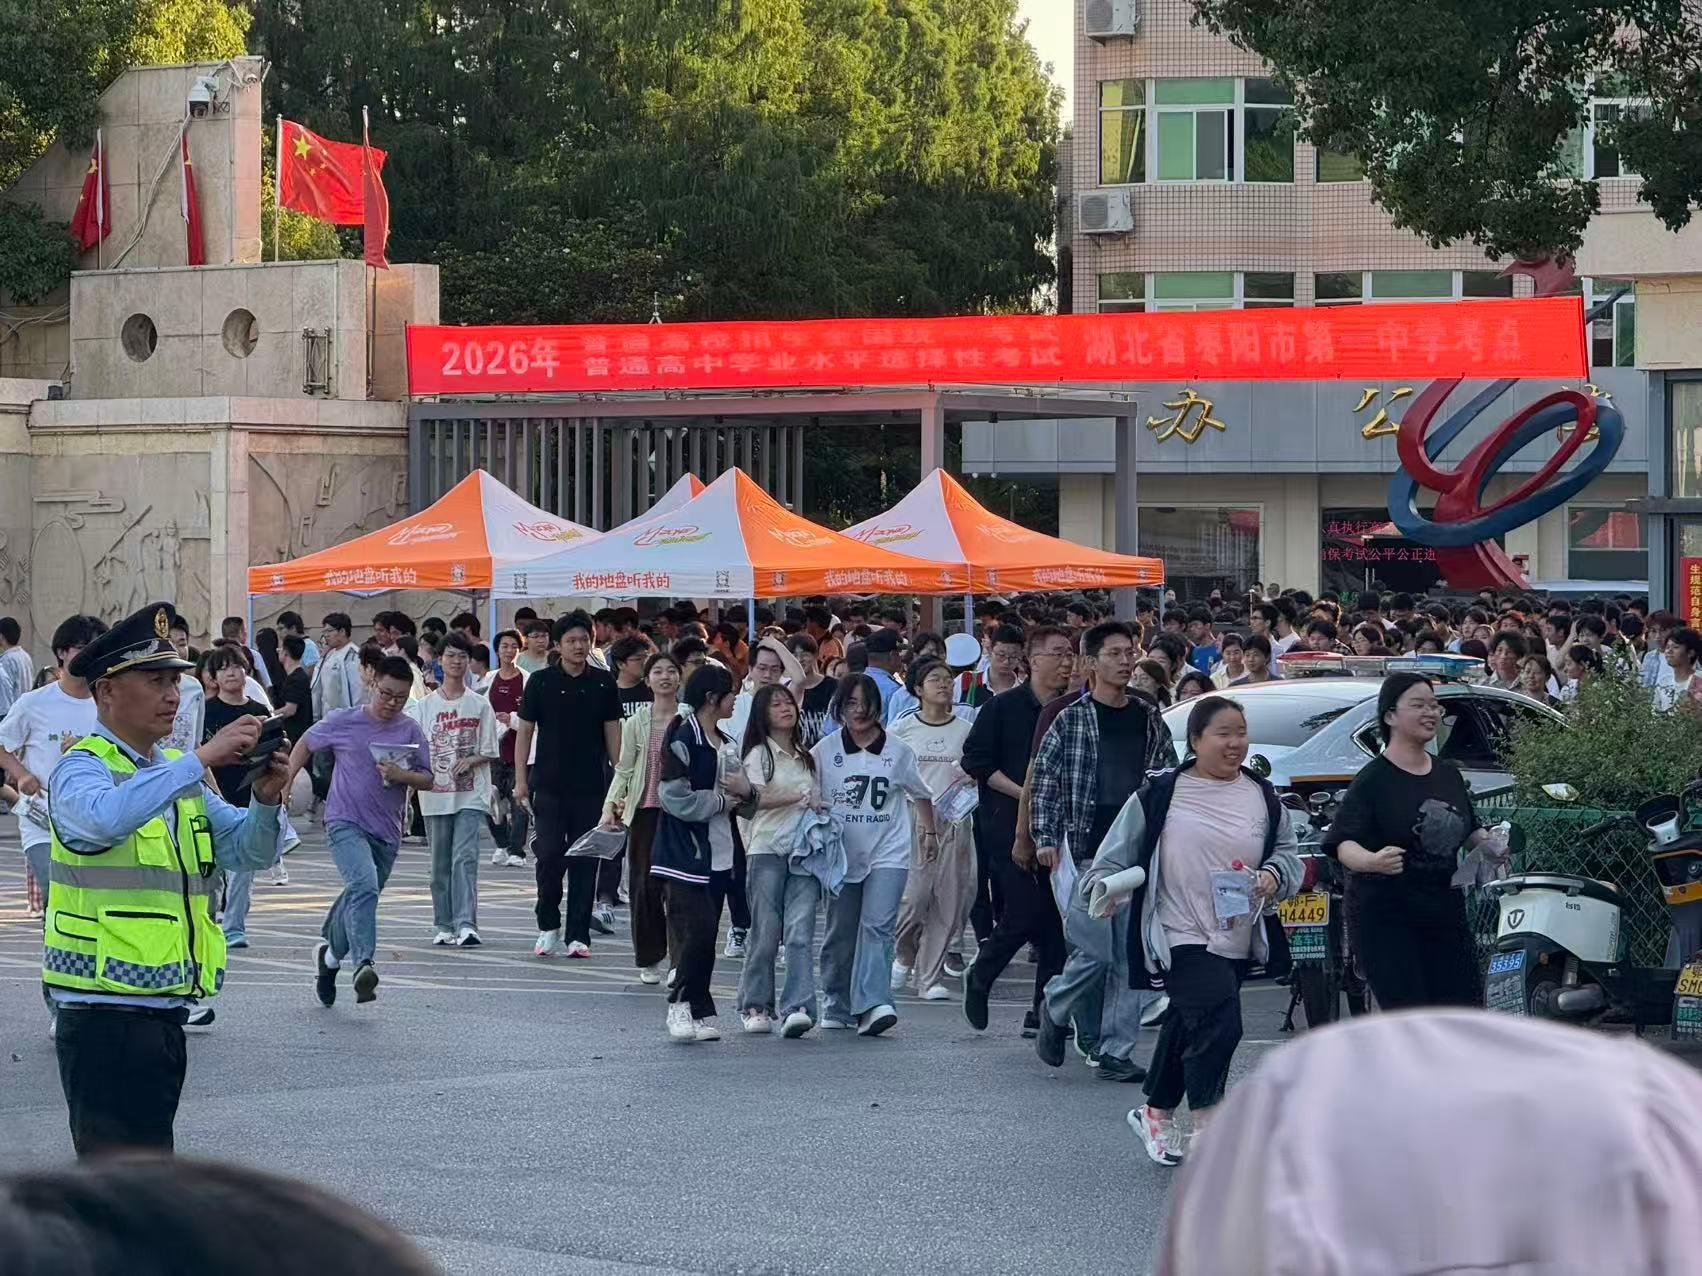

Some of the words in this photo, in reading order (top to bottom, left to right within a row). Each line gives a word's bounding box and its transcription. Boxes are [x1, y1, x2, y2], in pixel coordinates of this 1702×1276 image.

[441, 337, 560, 378] 2026年
[324, 567, 417, 585] 我的地盘听我的
[572, 571, 670, 589] 我的地盘听我的
[844, 775, 889, 810] 76
[1279, 907, 1325, 923] H4449
[1490, 957, 1521, 972] 35395
